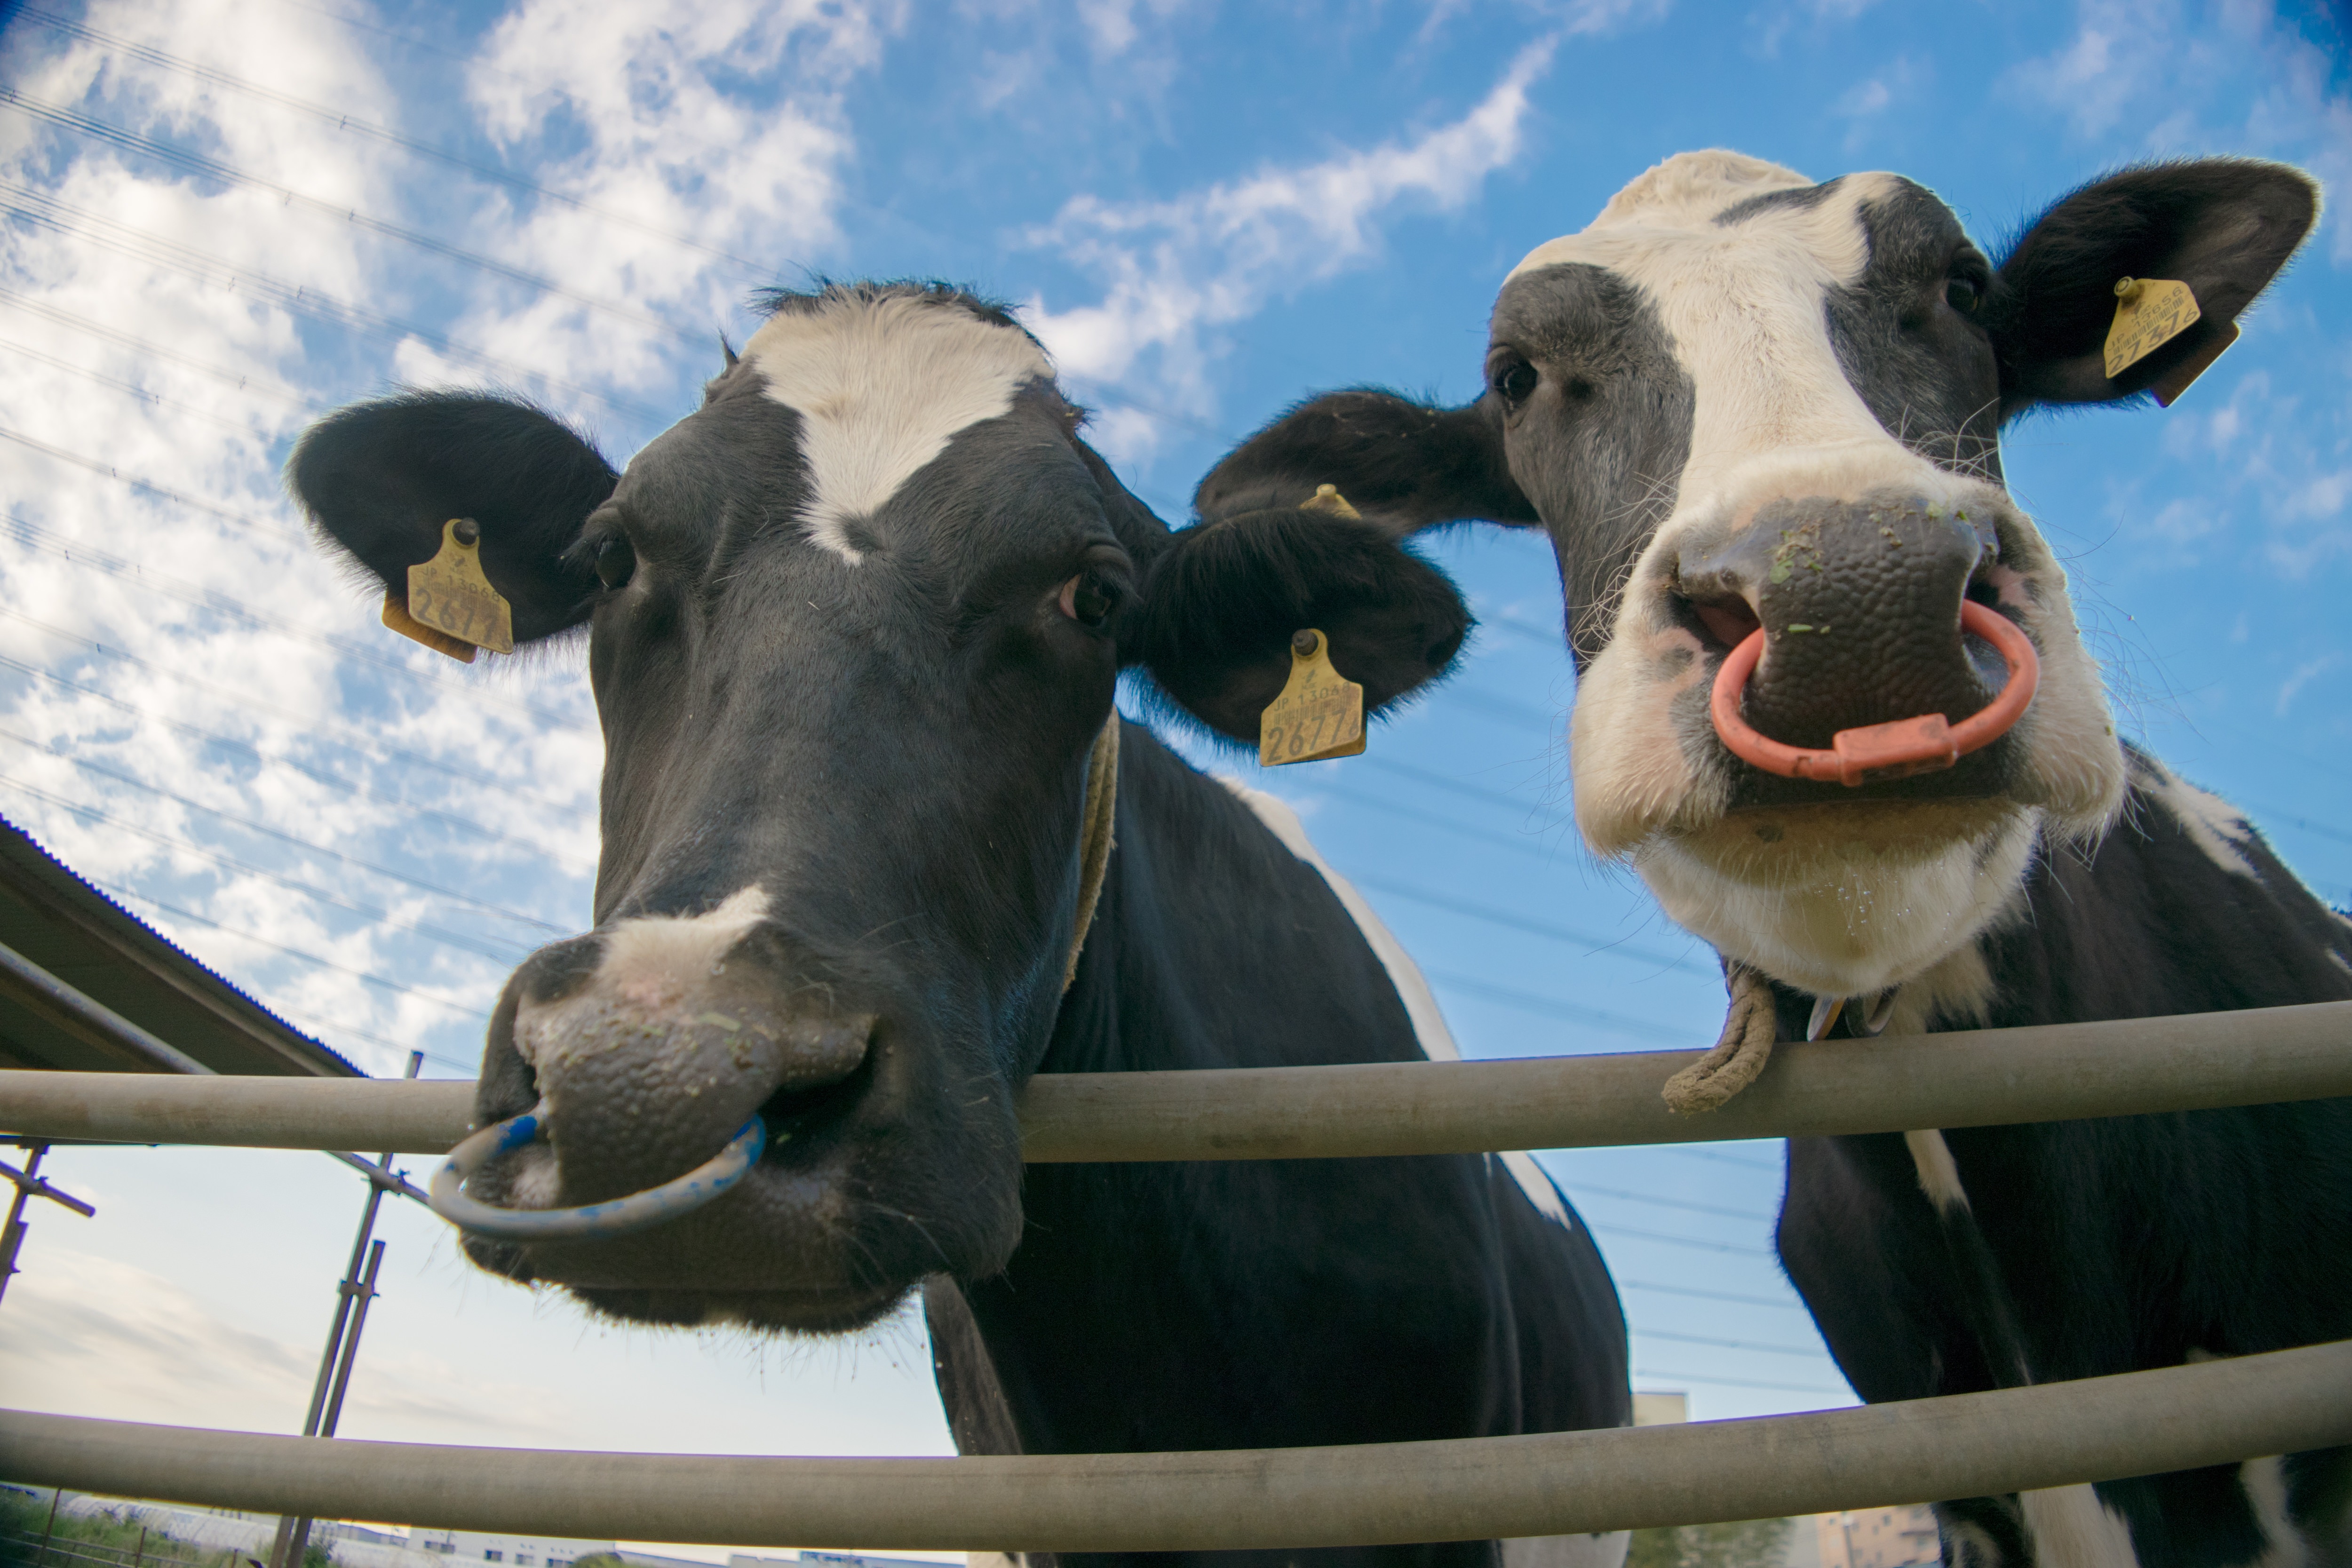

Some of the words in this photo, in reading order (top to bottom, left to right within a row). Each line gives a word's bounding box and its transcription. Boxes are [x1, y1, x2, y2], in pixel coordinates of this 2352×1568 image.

[2107, 333, 2125, 351] JP
[2133, 287, 2184, 327] 13656
[421, 566, 437, 577] JP
[1274, 698, 1288, 712] JP
[1298, 681, 1351, 705] 13068
